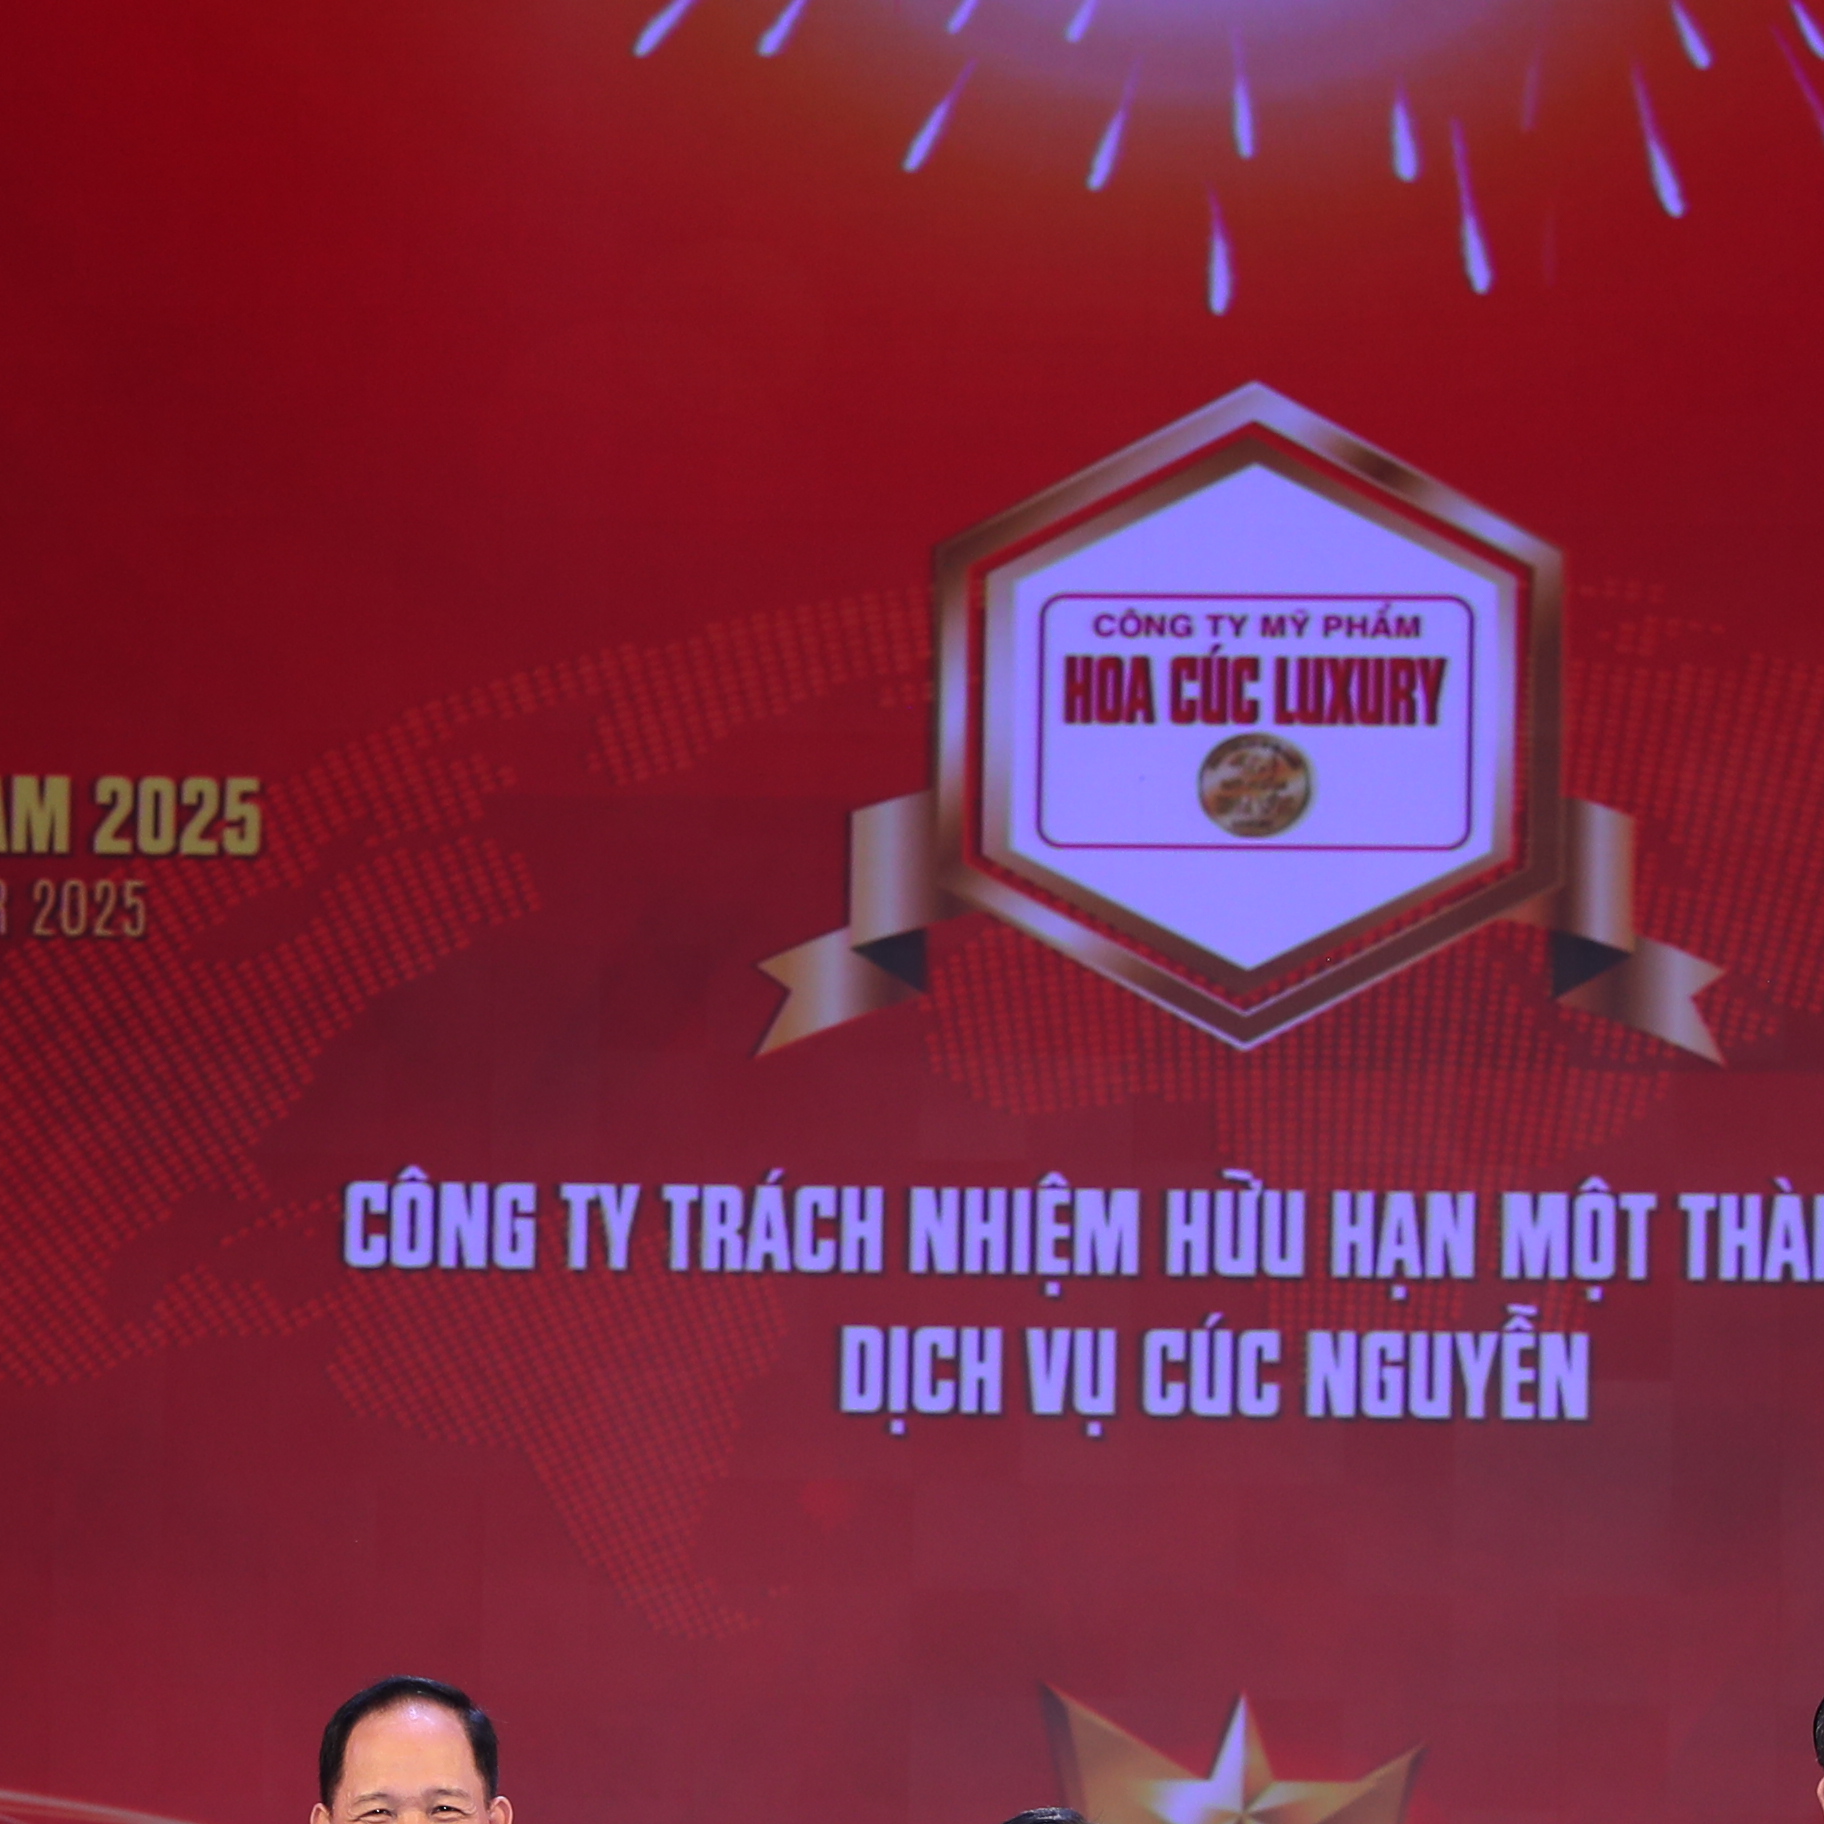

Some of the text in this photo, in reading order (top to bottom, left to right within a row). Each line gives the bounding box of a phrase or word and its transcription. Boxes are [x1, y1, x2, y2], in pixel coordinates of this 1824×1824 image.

[1093, 602, 1422, 639] CÔNG TY MỸ PHẨM
[1064, 644, 1448, 726] HOA CÚC LUXURY
[94, 776, 263, 855] 2025
[32, 879, 147, 938] 2025
[343, 1165, 537, 1270] CÔNG
[559, 1183, 641, 1271] TY
[663, 1168, 885, 1273] TRÁCH
[909, 1170, 1141, 1298] NHIỆM
[1166, 1167, 1305, 1279] HỮU
[1331, 1190, 1476, 1301] HẠN
[1501, 1176, 1657, 1303] MỘT
[840, 1303, 1590, 1437] DỊCH VỤ CÚC NGUYỄN
